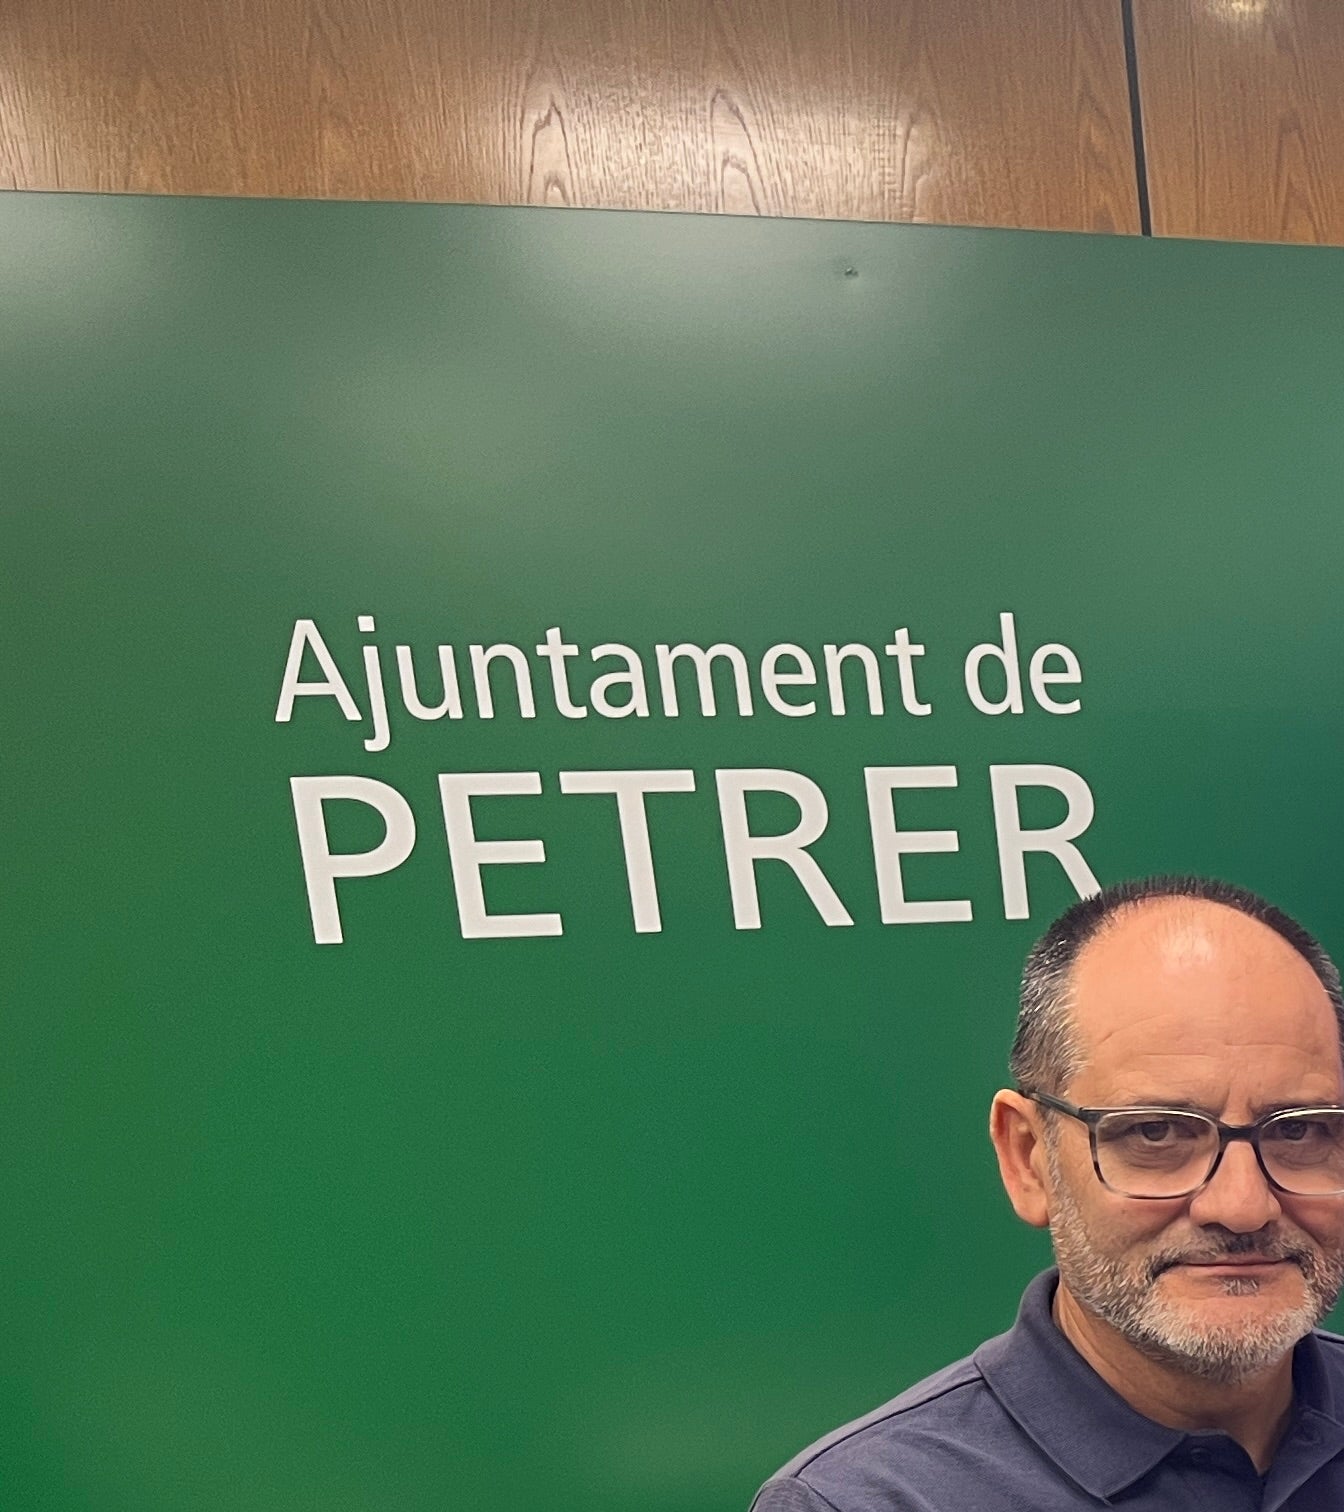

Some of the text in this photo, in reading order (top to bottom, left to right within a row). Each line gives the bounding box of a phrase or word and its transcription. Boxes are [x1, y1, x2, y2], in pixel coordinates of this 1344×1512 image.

[275, 612, 1083, 752] Ajuntament de
[289, 763, 1103, 945] PETRER
